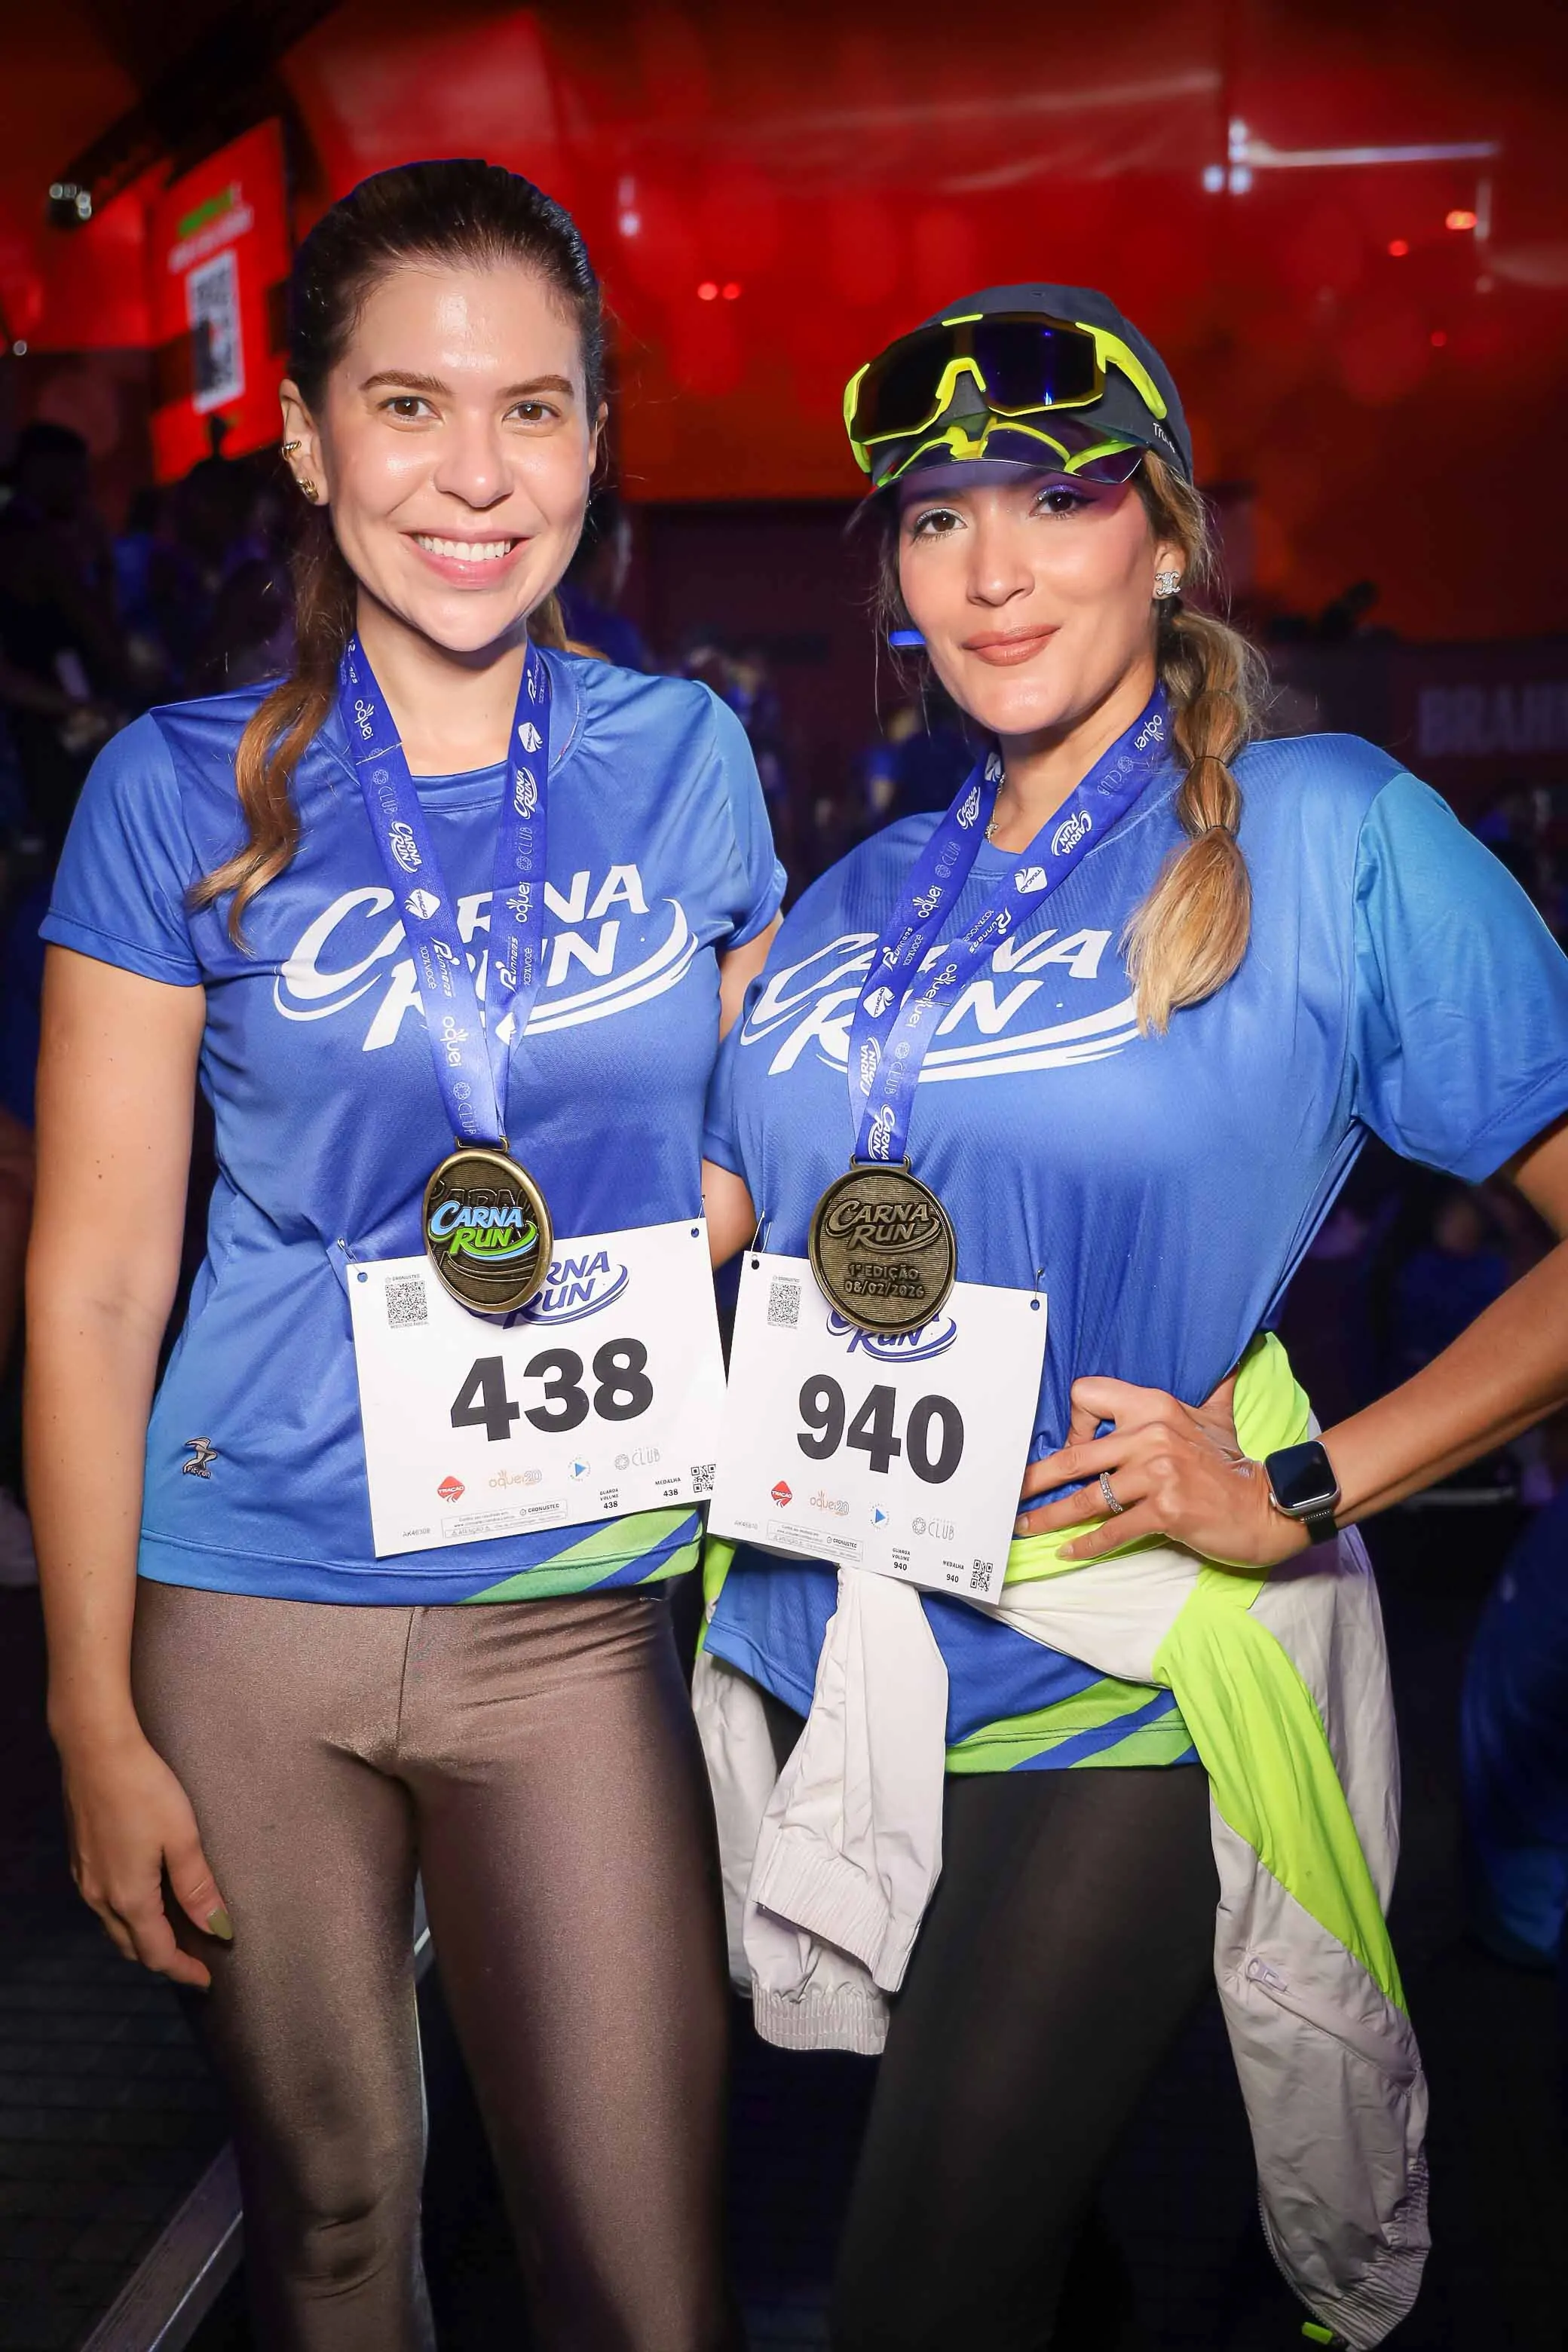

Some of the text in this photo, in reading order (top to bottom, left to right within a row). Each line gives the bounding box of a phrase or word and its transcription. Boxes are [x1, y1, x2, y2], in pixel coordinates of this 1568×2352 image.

[354, 700, 374, 740] oquei
[1135, 715, 1164, 750] oquei
[514, 770, 530, 819] CARNA
[523, 775, 536, 813] RUN
[1098, 770, 1122, 795] CLUB
[378, 786, 397, 814] CLUB
[392, 821, 423, 866] CARNA
[519, 827, 532, 854] CLUB
[1055, 813, 1078, 849] RUN
[1061, 810, 1092, 854] CARNA
[389, 832, 413, 866] RUN
[942, 841, 960, 865] CLUB
[507, 881, 532, 923] oquei
[913, 885, 942, 918] oquei
[923, 964, 957, 1002] oquei
[440, 1016, 468, 1067] oquei
[859, 1044, 871, 1097] CARNA
[884, 1061, 904, 1094] CLUB
[871, 1114, 884, 1156] RUN
[880, 1104, 896, 1160] CARNA
[430, 1200, 523, 1236] CARNA
[828, 1200, 929, 1232] CARNA
[449, 1227, 516, 1255] RUN
[847, 1223, 917, 1251] RUN
[844, 1281, 925, 1297] 08/02/2026
[865, 1265, 919, 1281] EDIÇÃO
[450, 1338, 654, 1442] 438
[797, 1374, 964, 1484] 940
[528, 1503, 559, 1513] CRONUSTEC
[833, 1538, 857, 1548] CRONUSTEC
[928, 1521, 954, 1540] CLUB
[893, 1554, 910, 1562] VOLUME
[893, 1561, 908, 1571] 940
[942, 1560, 964, 1570] MEDALHA
[946, 1573, 959, 1583] 940
